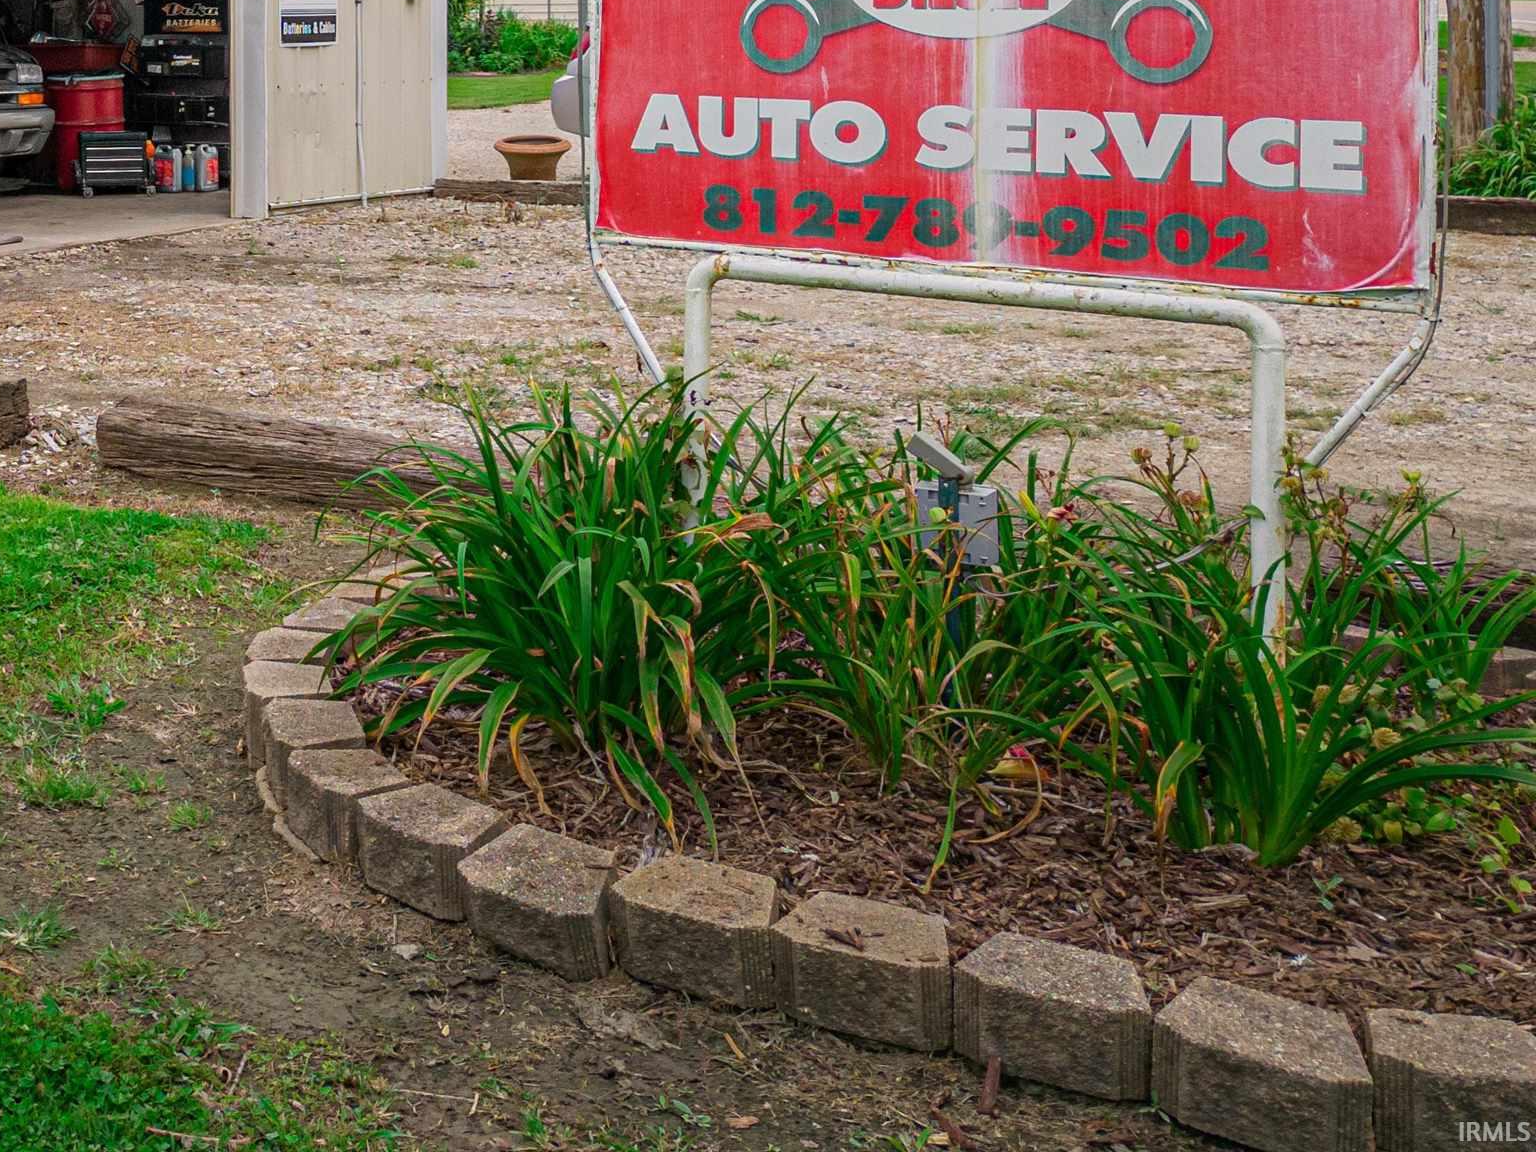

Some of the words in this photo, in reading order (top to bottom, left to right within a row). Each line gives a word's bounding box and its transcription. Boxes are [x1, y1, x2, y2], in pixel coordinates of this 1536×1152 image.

[166, 18, 217, 27] BATTERIES
[631, 92, 888, 166] AUTO
[914, 104, 1368, 195] SERVICE
[702, 183, 1271, 271] 812-789-9502
